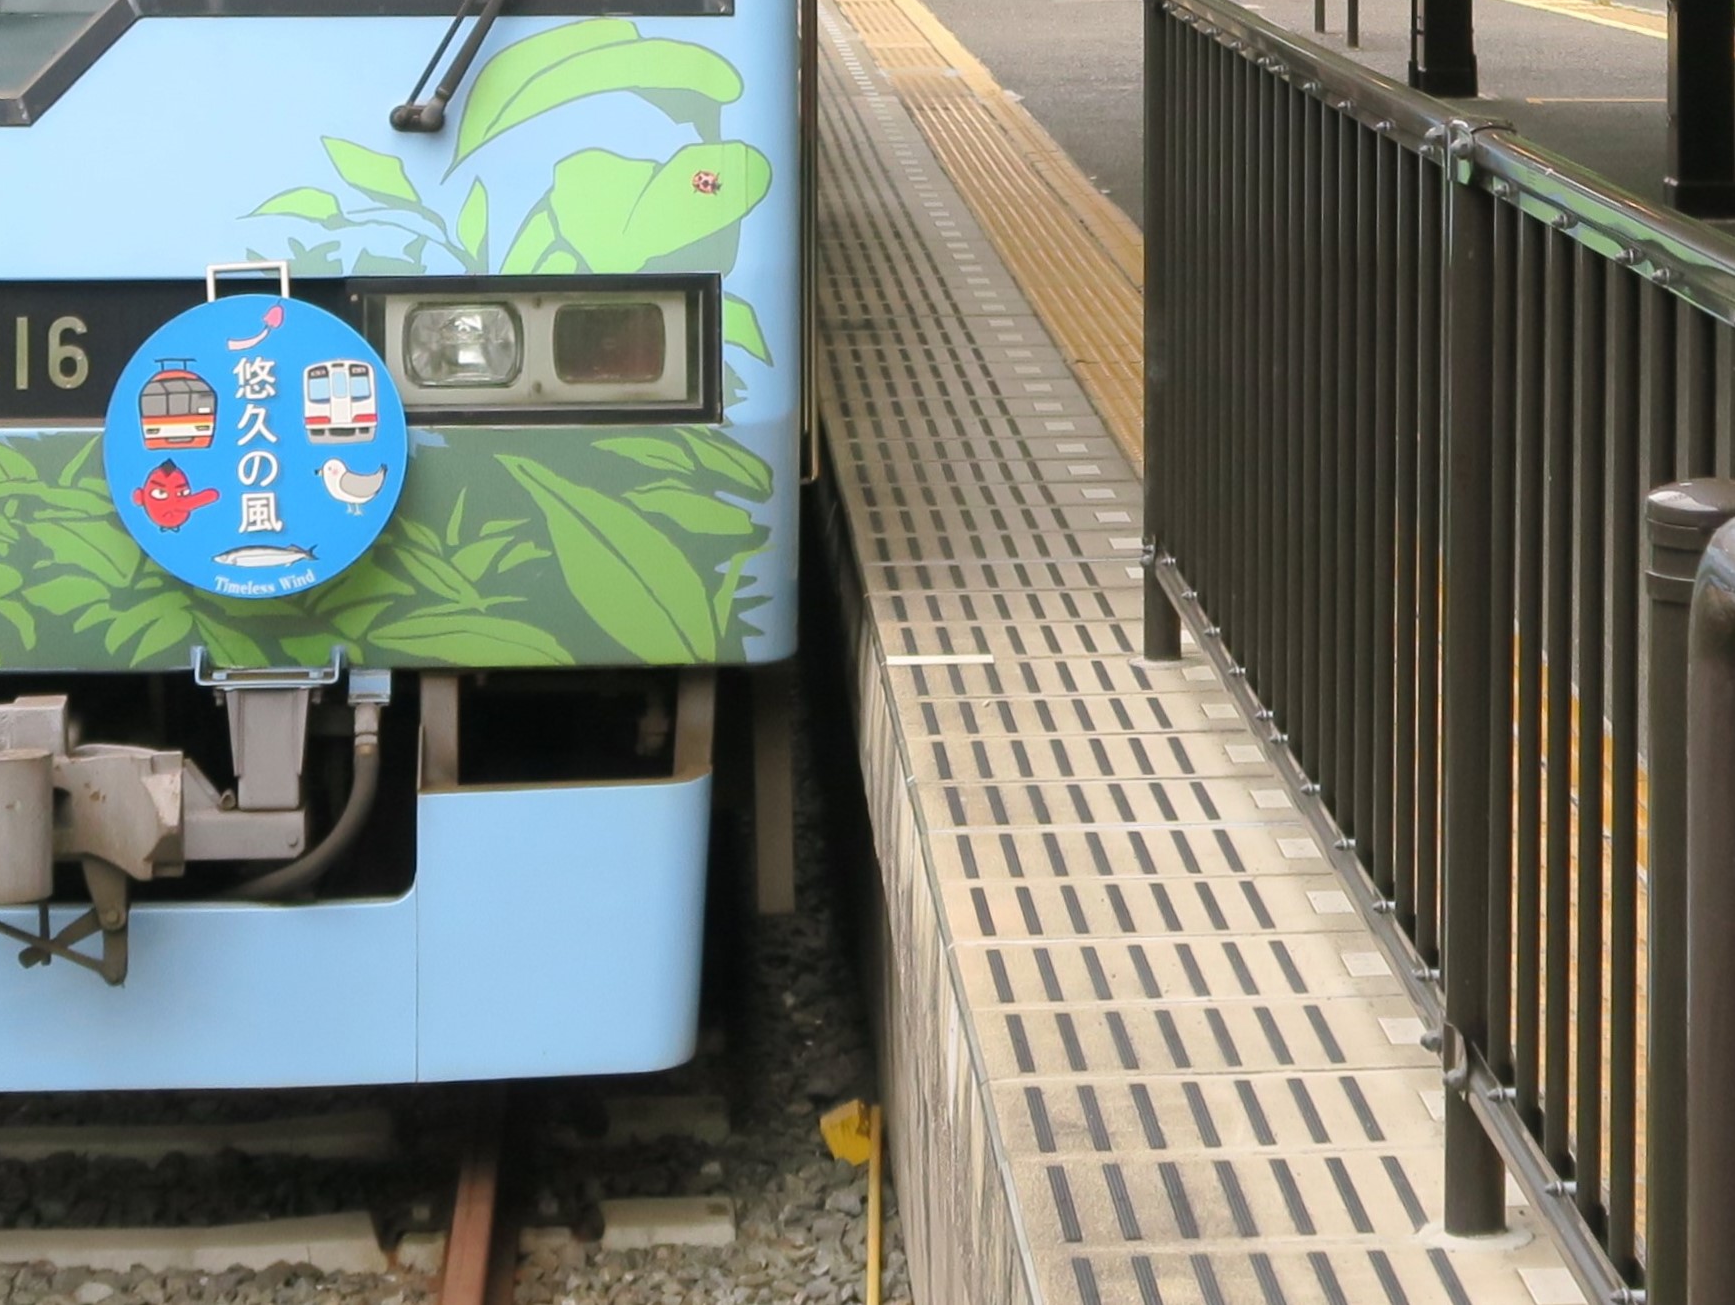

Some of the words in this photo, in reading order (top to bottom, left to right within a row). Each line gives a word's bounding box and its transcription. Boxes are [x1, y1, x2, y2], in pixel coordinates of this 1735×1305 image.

[232, 356, 283, 534] 悠久の風
[215, 575, 275, 594] Timeless
[279, 569, 315, 590] Wind
